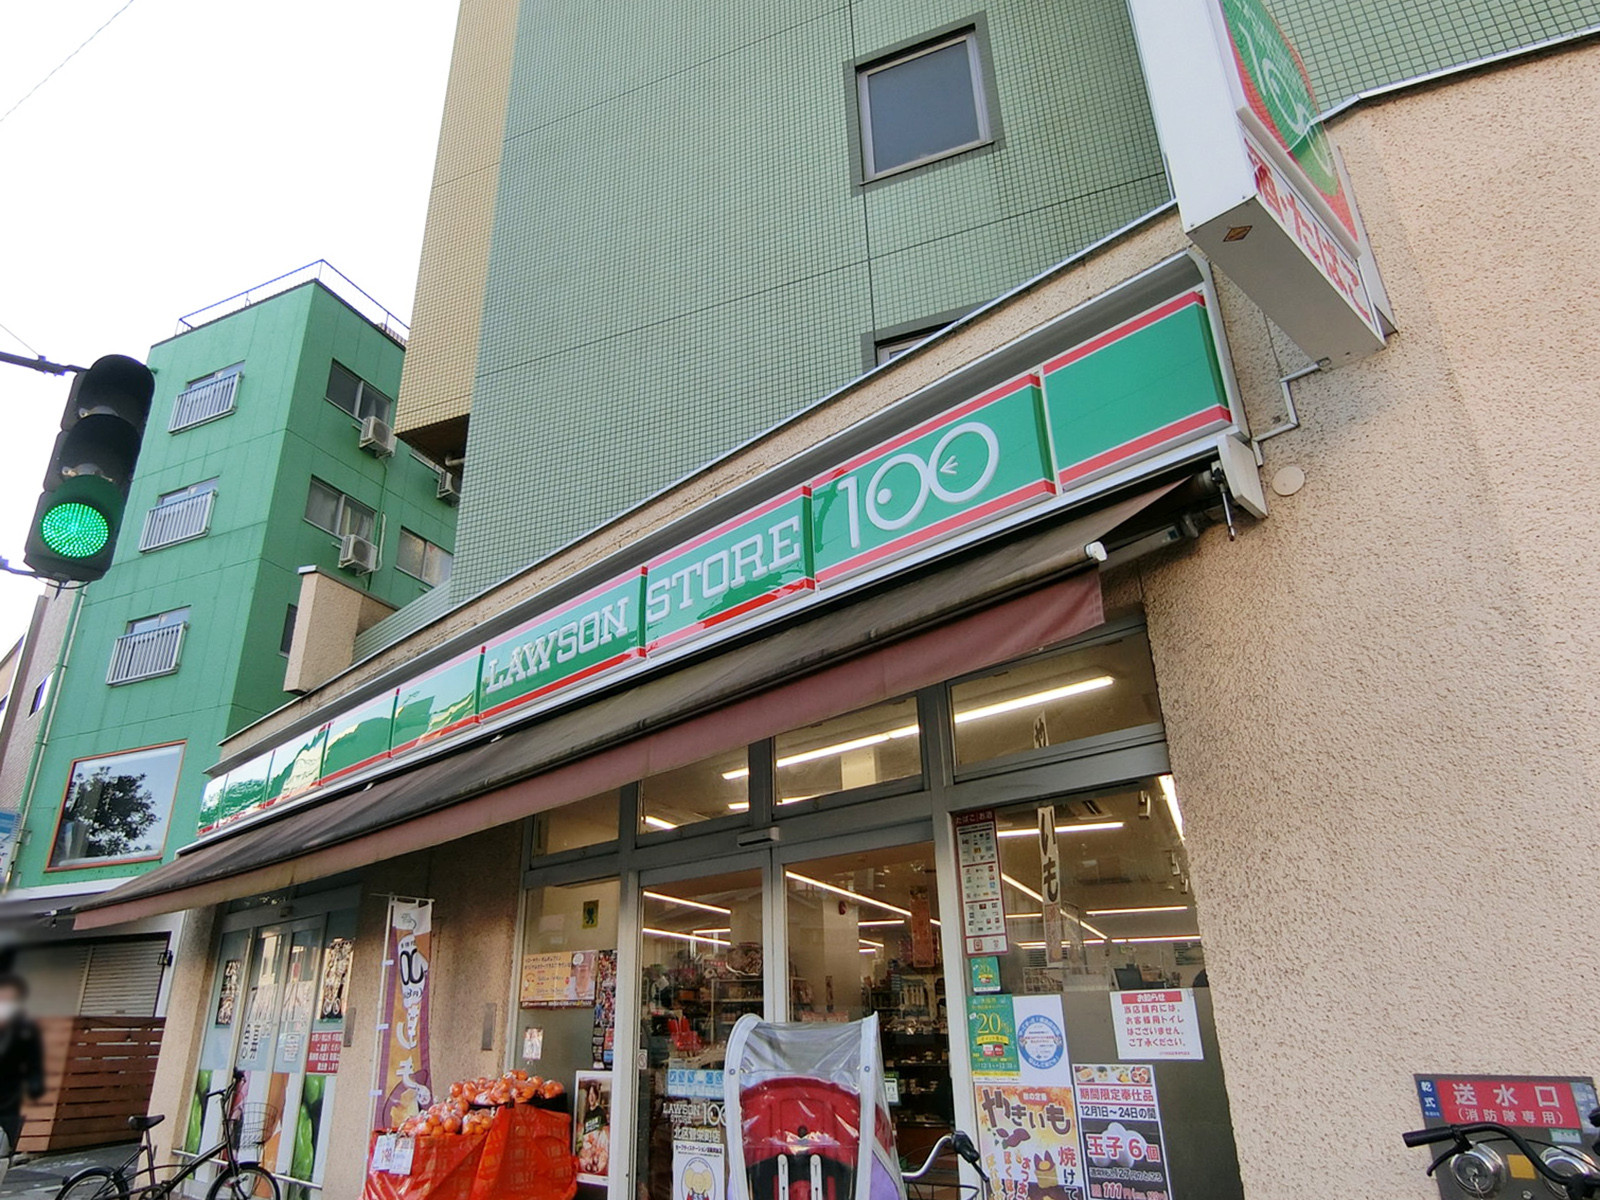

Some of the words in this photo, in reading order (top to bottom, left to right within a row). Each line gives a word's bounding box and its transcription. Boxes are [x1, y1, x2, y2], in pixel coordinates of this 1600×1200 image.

[485, 597, 631, 694] LAWSON
[646, 515, 801, 623] STORE
[838, 421, 1000, 550] 100
[1136, 993, 1166, 1003] お知らせ
[1079, 1088, 1154, 1102] 期間限定奉仕品
[1452, 1083, 1560, 1108] 送水口
[662, 1102, 701, 1117] LAWSON
[981, 1089, 1071, 1135] やきいも
[1087, 1135, 1160, 1162] 玉子6個
